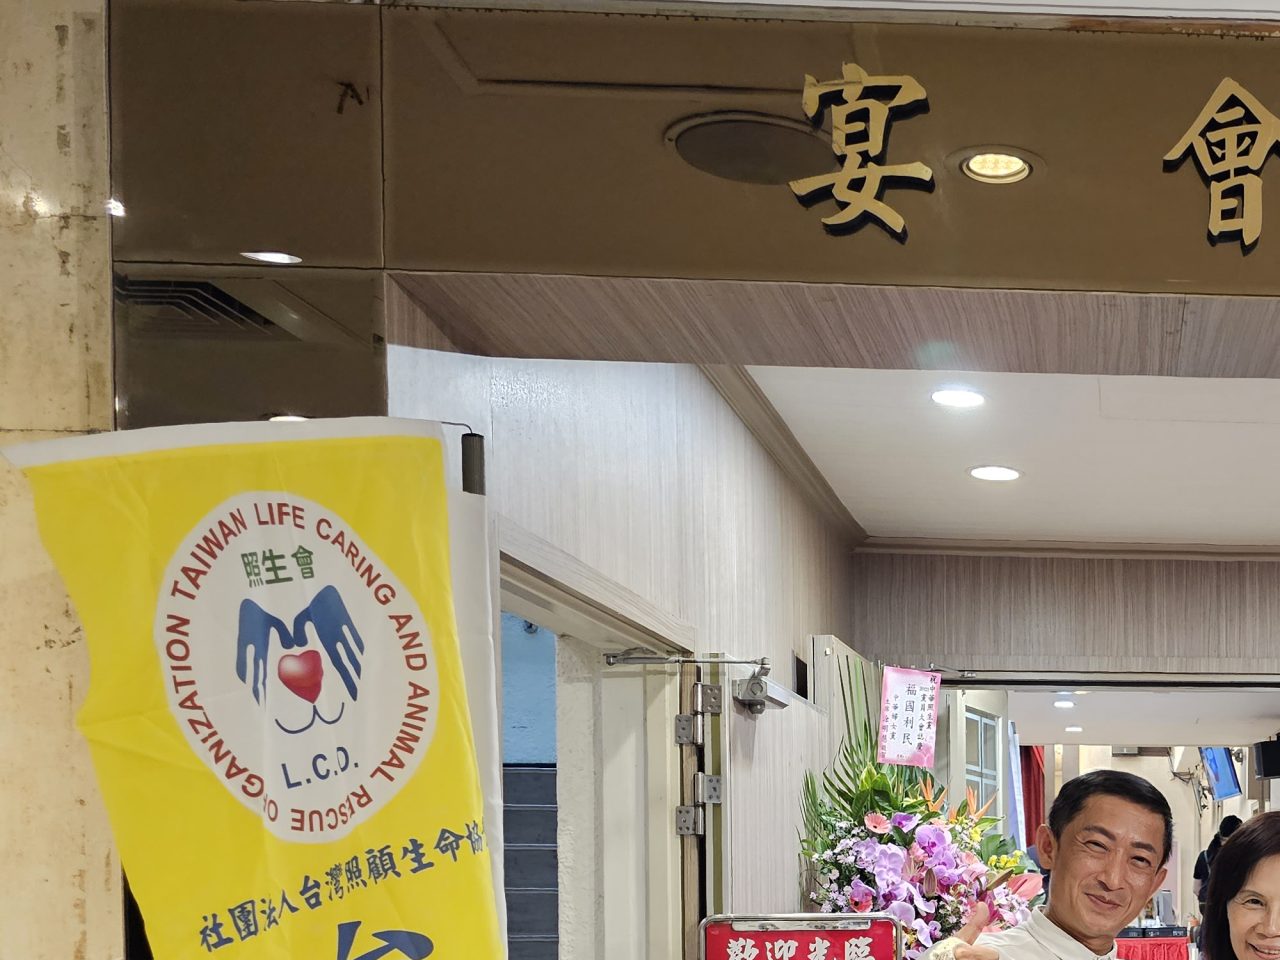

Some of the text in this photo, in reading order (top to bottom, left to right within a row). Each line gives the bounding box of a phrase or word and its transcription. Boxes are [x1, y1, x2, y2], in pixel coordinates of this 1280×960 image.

[170, 507, 248, 600] TAIWAN
[254, 502, 305, 529] LIFE
[241, 545, 315, 588] 照生會
[316, 518, 396, 606] CARING
[388, 614, 428, 671] AND
[166, 614, 278, 822] OGANIZATION
[370, 681, 430, 782] ANIMAL
[902, 684, 917, 746] 福國利民
[199, 815, 487, 953] 社團法人台灣照顧生命協
